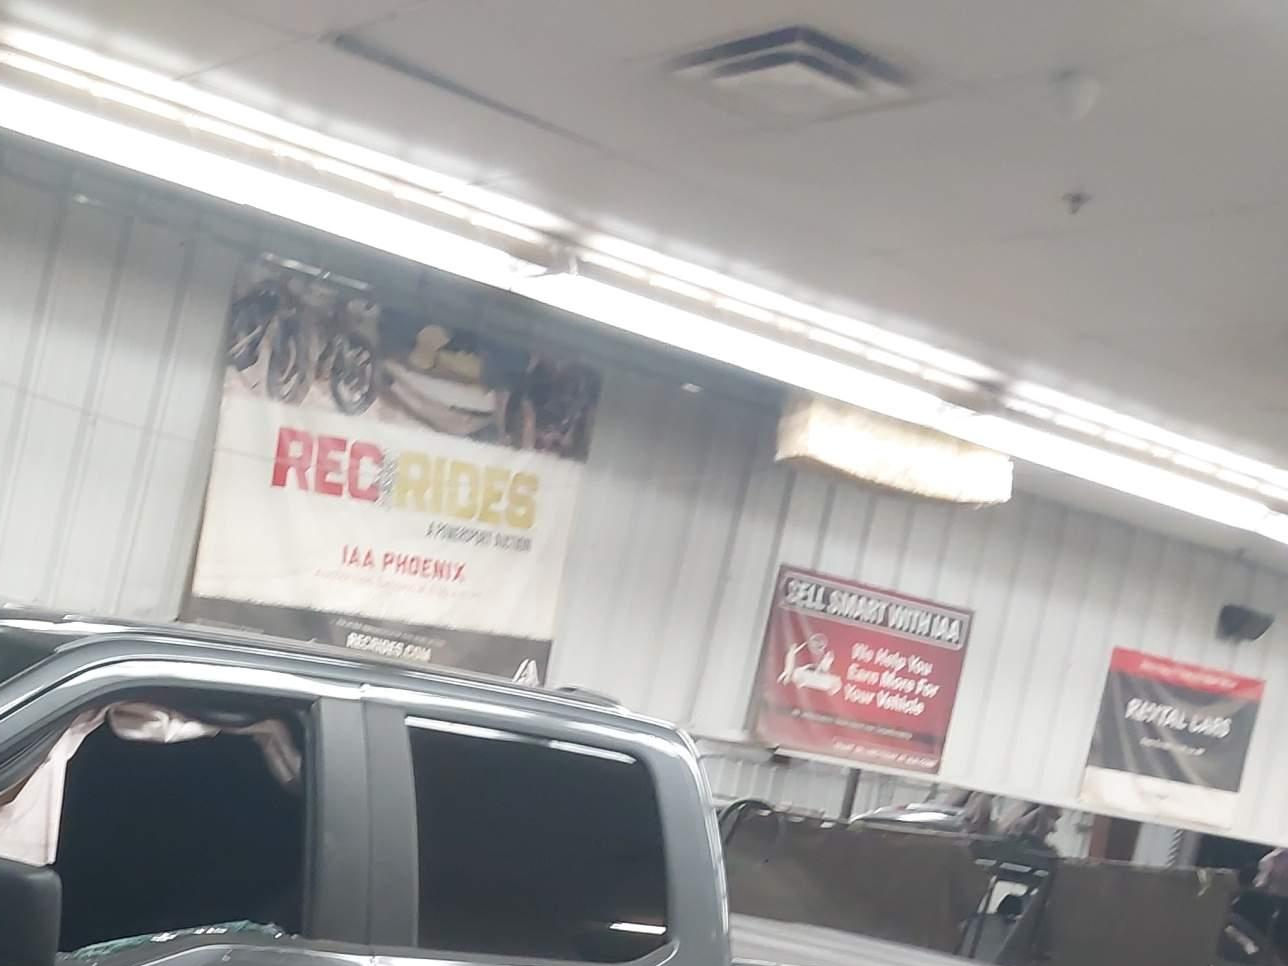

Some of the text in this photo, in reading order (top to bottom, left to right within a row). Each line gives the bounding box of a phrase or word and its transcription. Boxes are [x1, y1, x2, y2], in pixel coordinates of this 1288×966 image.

[271, 427, 538, 529] REC RIDES
[341, 544, 467, 583] IAA PHOENIX
[786, 579, 963, 645] SELL SMART WITH IAA
[852, 643, 934, 676] We Help You
[847, 663, 941, 698] Earn More For
[843, 684, 926, 716] Your Vehicle
